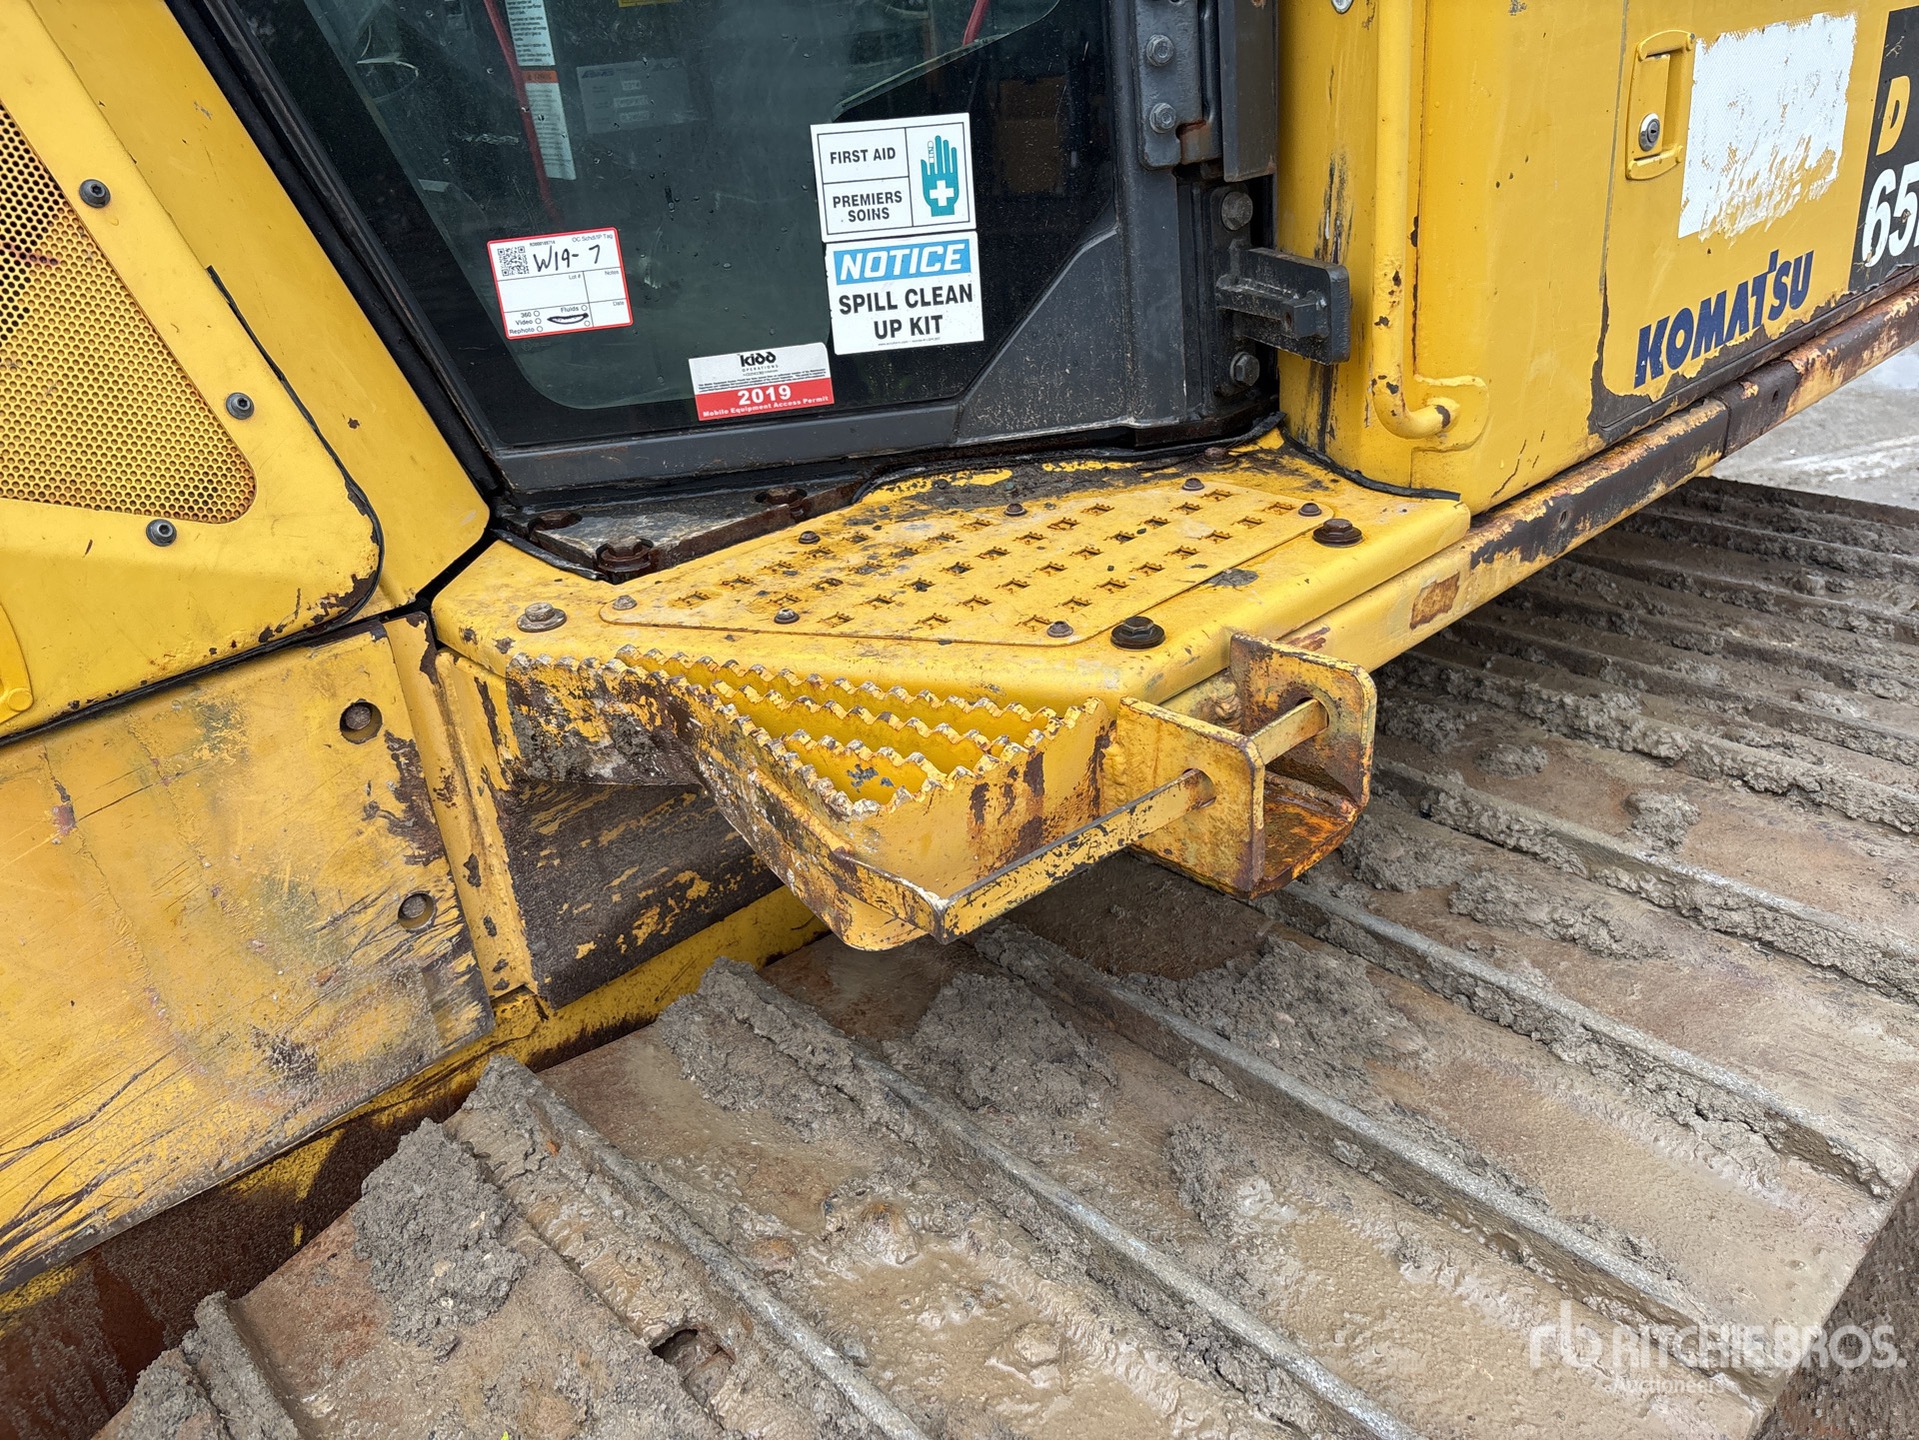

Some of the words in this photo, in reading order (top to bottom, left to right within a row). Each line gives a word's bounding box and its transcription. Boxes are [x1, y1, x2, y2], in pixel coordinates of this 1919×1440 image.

[1876, 75, 1910, 156] D
[830, 149, 868, 164] FIRST
[873, 147, 896, 161] AID
[832, 190, 903, 208] PREMIERS
[848, 207, 890, 222] SOINS
[1862, 161, 1919, 268] 65
[588, 244, 601, 264] 7
[840, 244, 965, 281] NOTICE
[838, 291, 898, 315] SPILL
[904, 283, 973, 308] CLEAN
[520, 311, 532, 319] 360
[1633, 249, 1815, 389] KOMATSU
[509, 327, 535, 335] Rephoto
[874, 320, 902, 340] UP
[910, 314, 944, 336] KIT
[740, 351, 777, 368] kidd
[742, 364, 779, 373] OPERATIONS
[737, 384, 792, 406] 2019
[703, 408, 729, 418] Mobile
[730, 402, 772, 414] Equipment
[773, 398, 802, 409] Access
[802, 395, 829, 405] Permit
